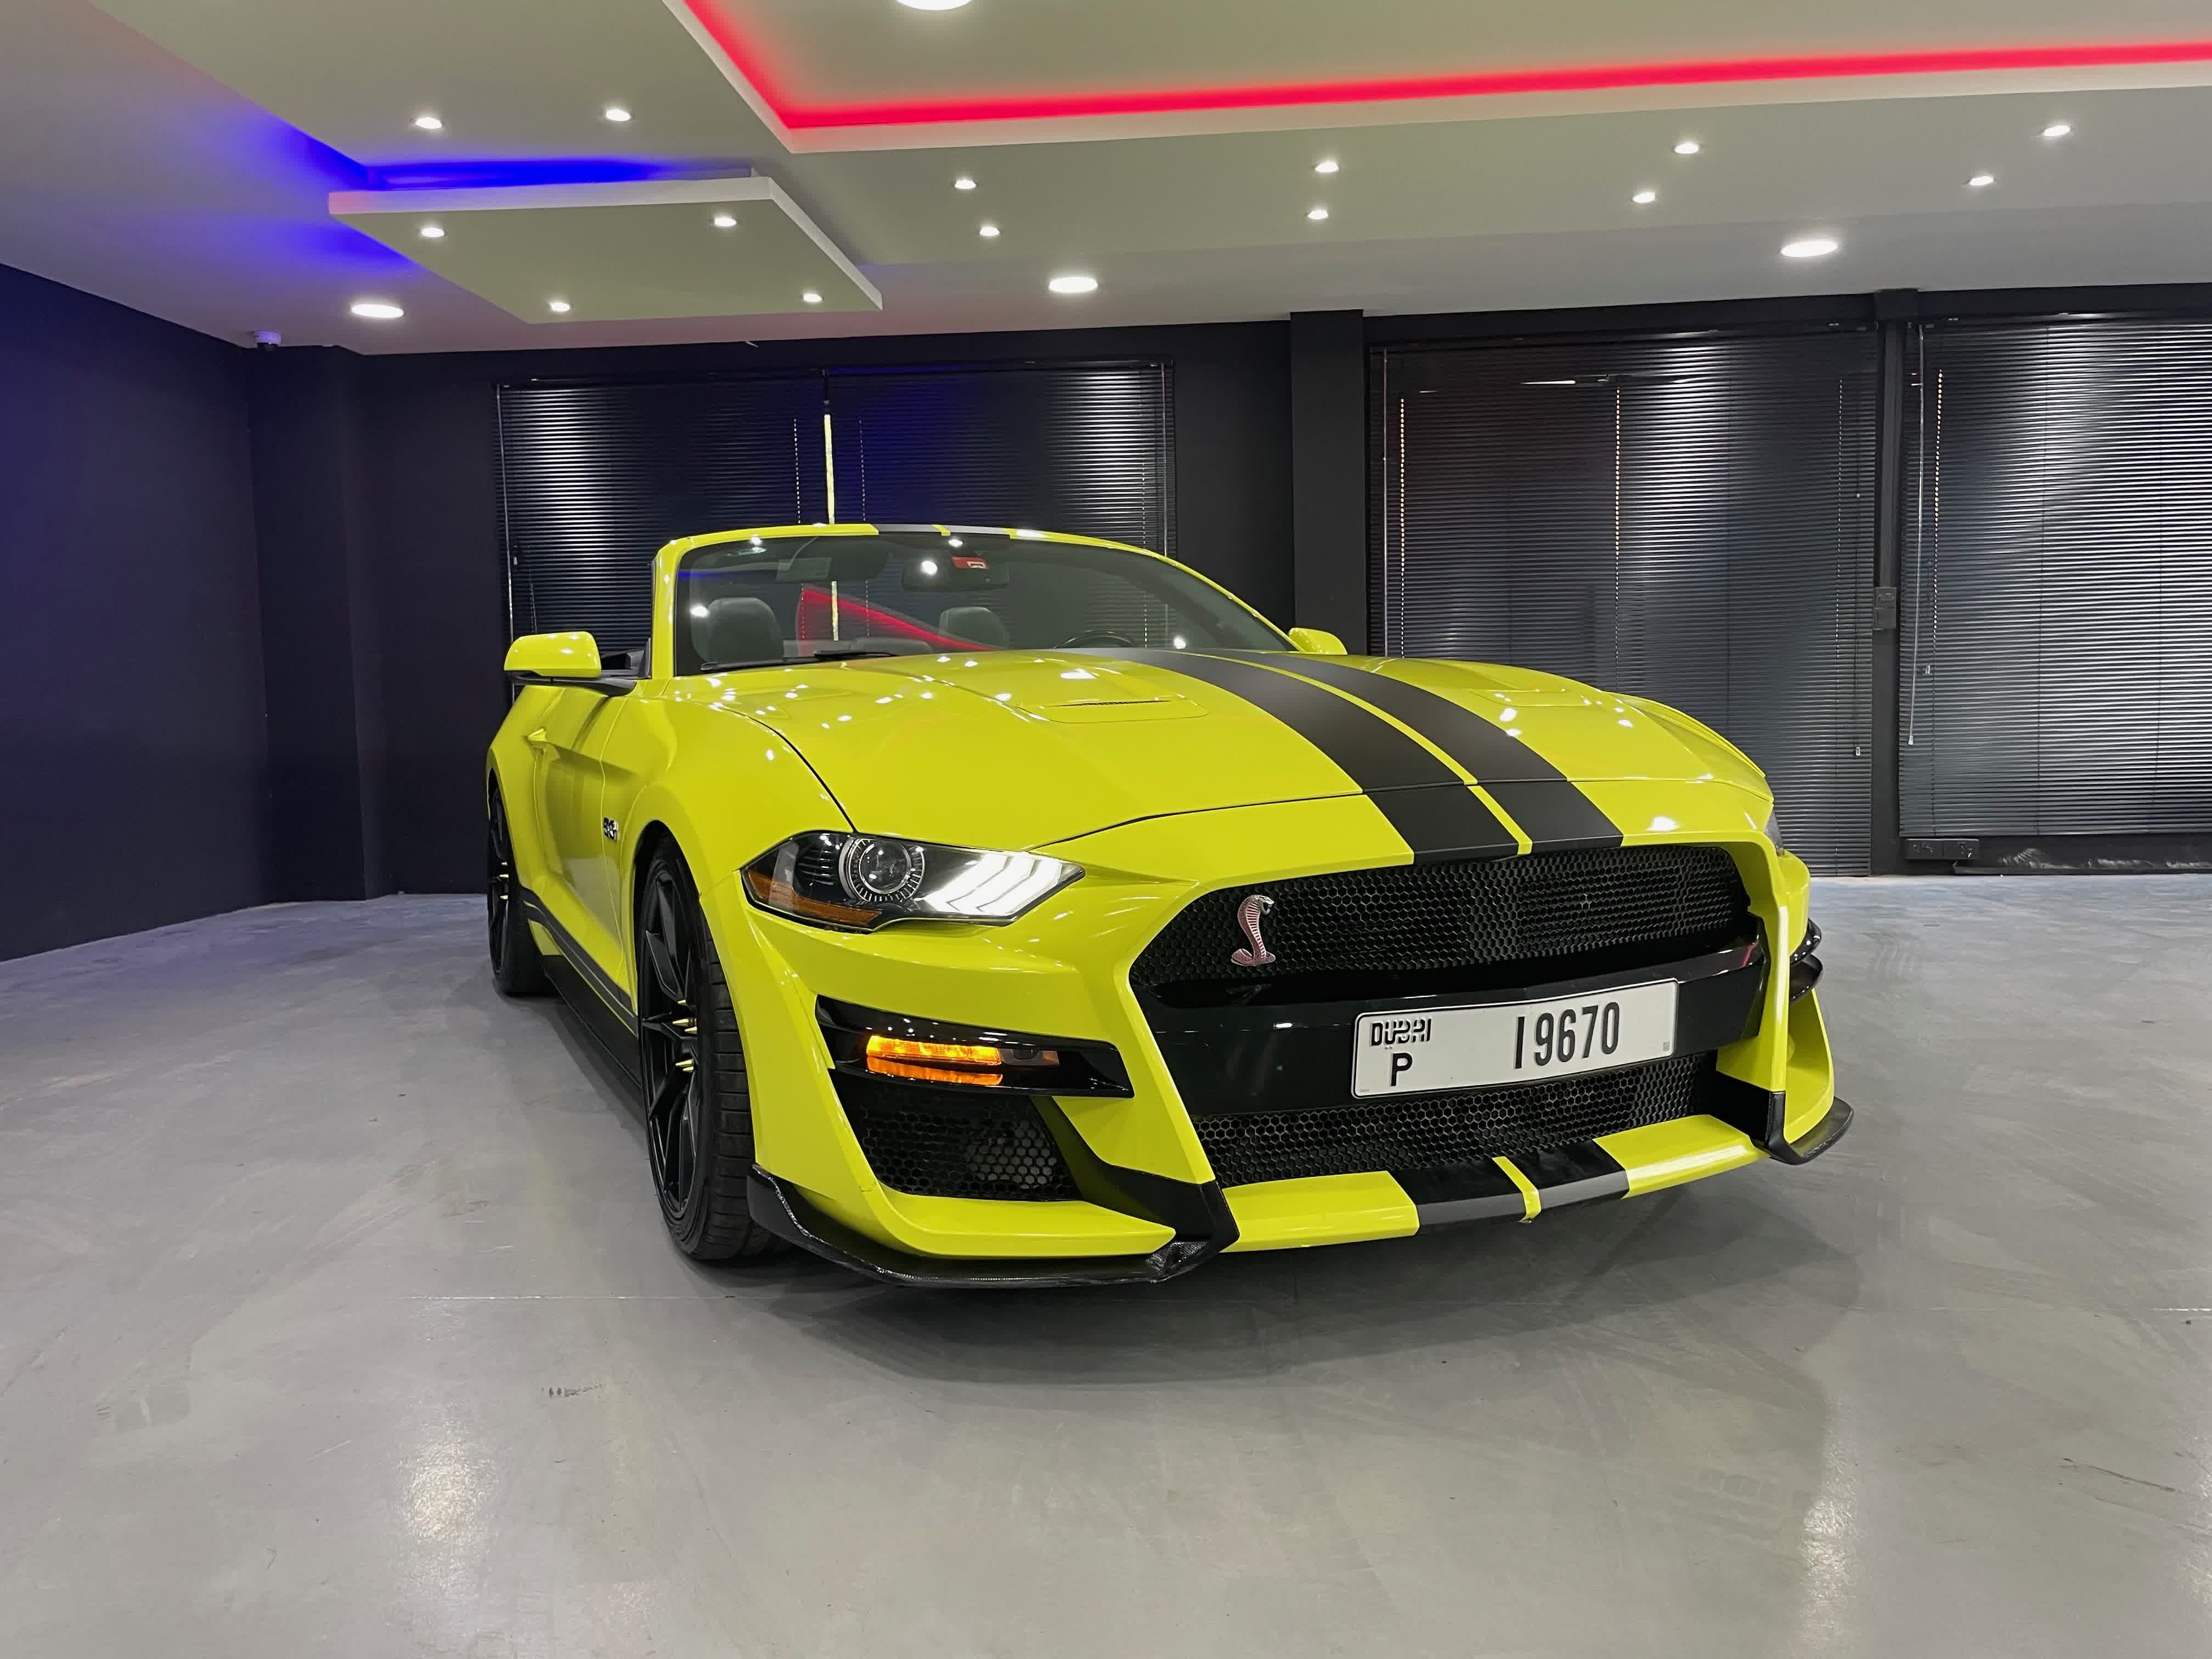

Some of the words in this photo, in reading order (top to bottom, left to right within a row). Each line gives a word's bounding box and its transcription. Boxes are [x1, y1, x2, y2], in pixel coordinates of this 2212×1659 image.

[1371, 1018, 1431, 1046] DUBAI
[1514, 1002, 1620, 1069] 19670
[1390, 1052, 1413, 1086] P
